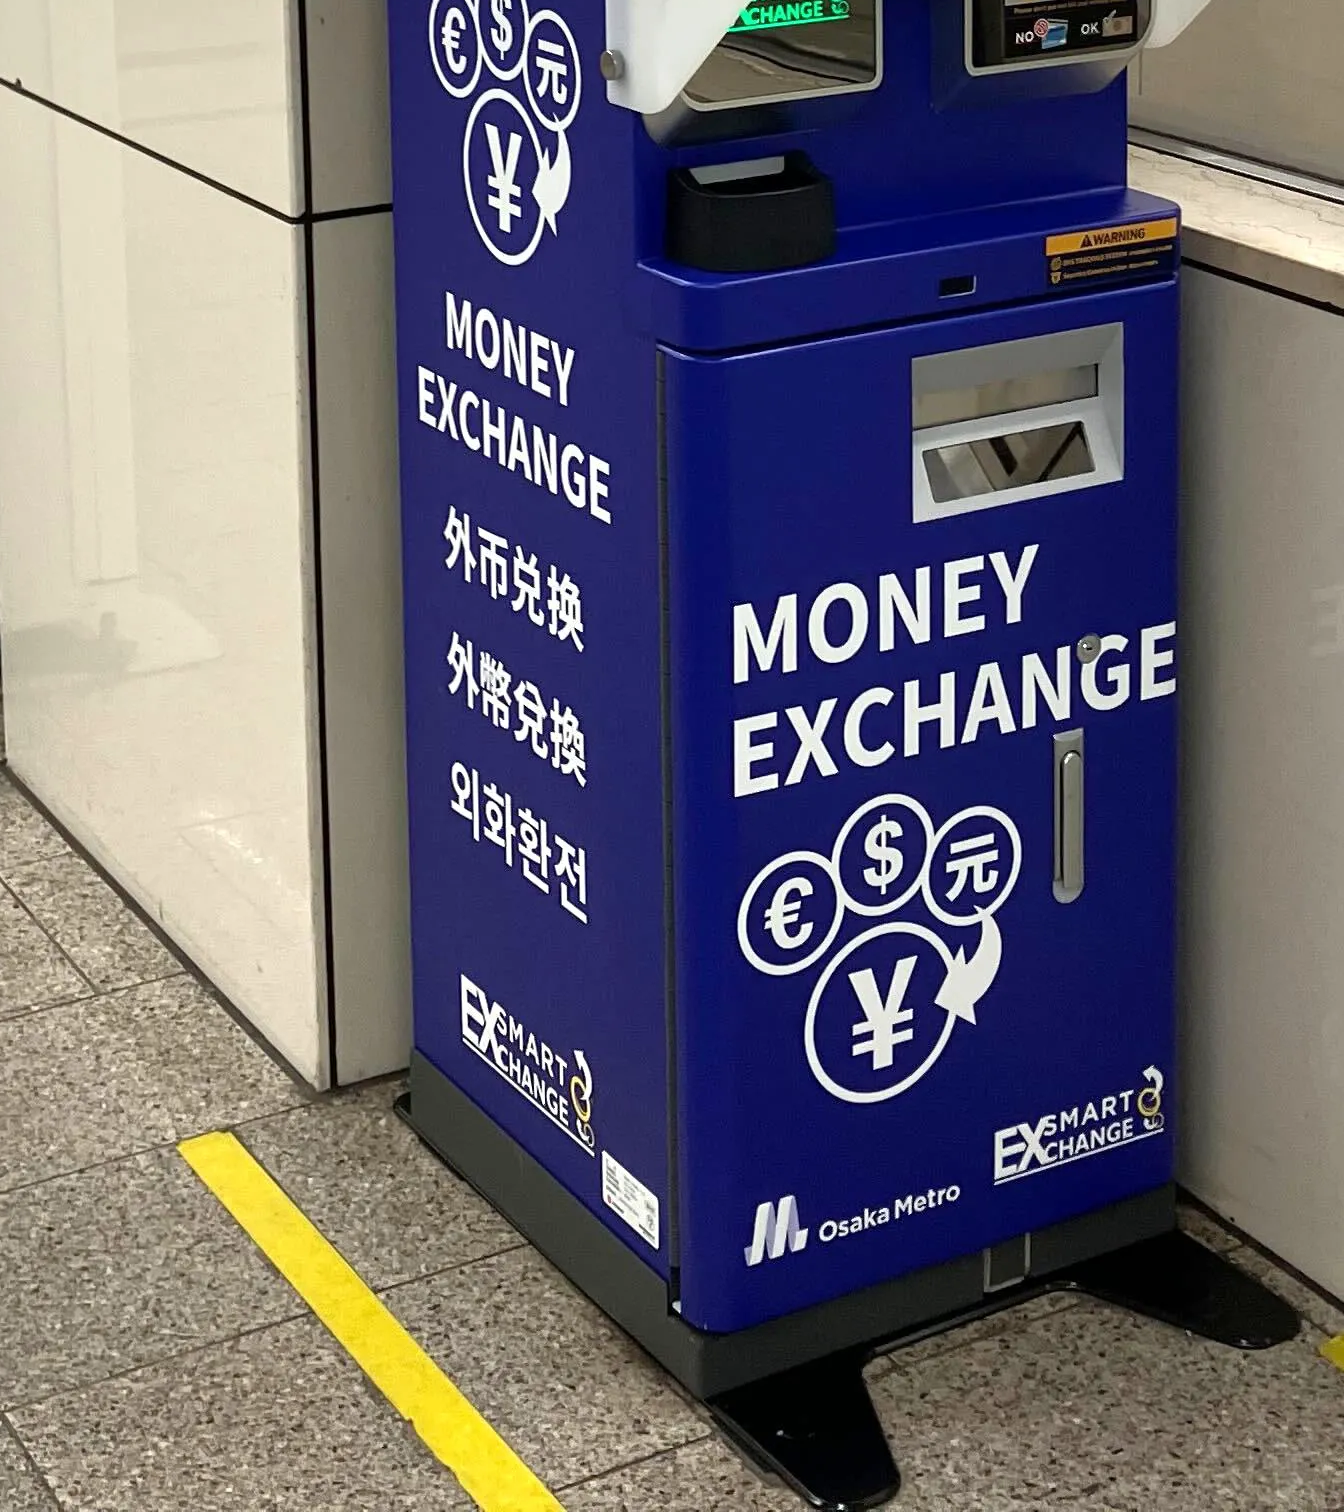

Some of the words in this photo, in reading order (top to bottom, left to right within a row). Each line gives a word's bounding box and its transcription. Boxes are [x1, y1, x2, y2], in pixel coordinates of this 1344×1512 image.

[1016, 31, 1034, 44] NO
[1081, 22, 1099, 34] OK
[1093, 228, 1145, 245] WARNING
[446, 291, 575, 407] MONEY
[418, 365, 611, 524] EXCHANGE
[443, 505, 584, 652] 外币兑换
[733, 543, 1039, 684] MONEY
[447, 631, 587, 788] 外幣兌換
[733, 621, 1176, 797] EXCHANGE
[450, 762, 588, 924] 외화환전
[497, 1009, 567, 1086] SMART
[1042, 1090, 1133, 1136] SMART
[818, 1207, 889, 1243] Osaka
[894, 1185, 960, 1220] Metro
